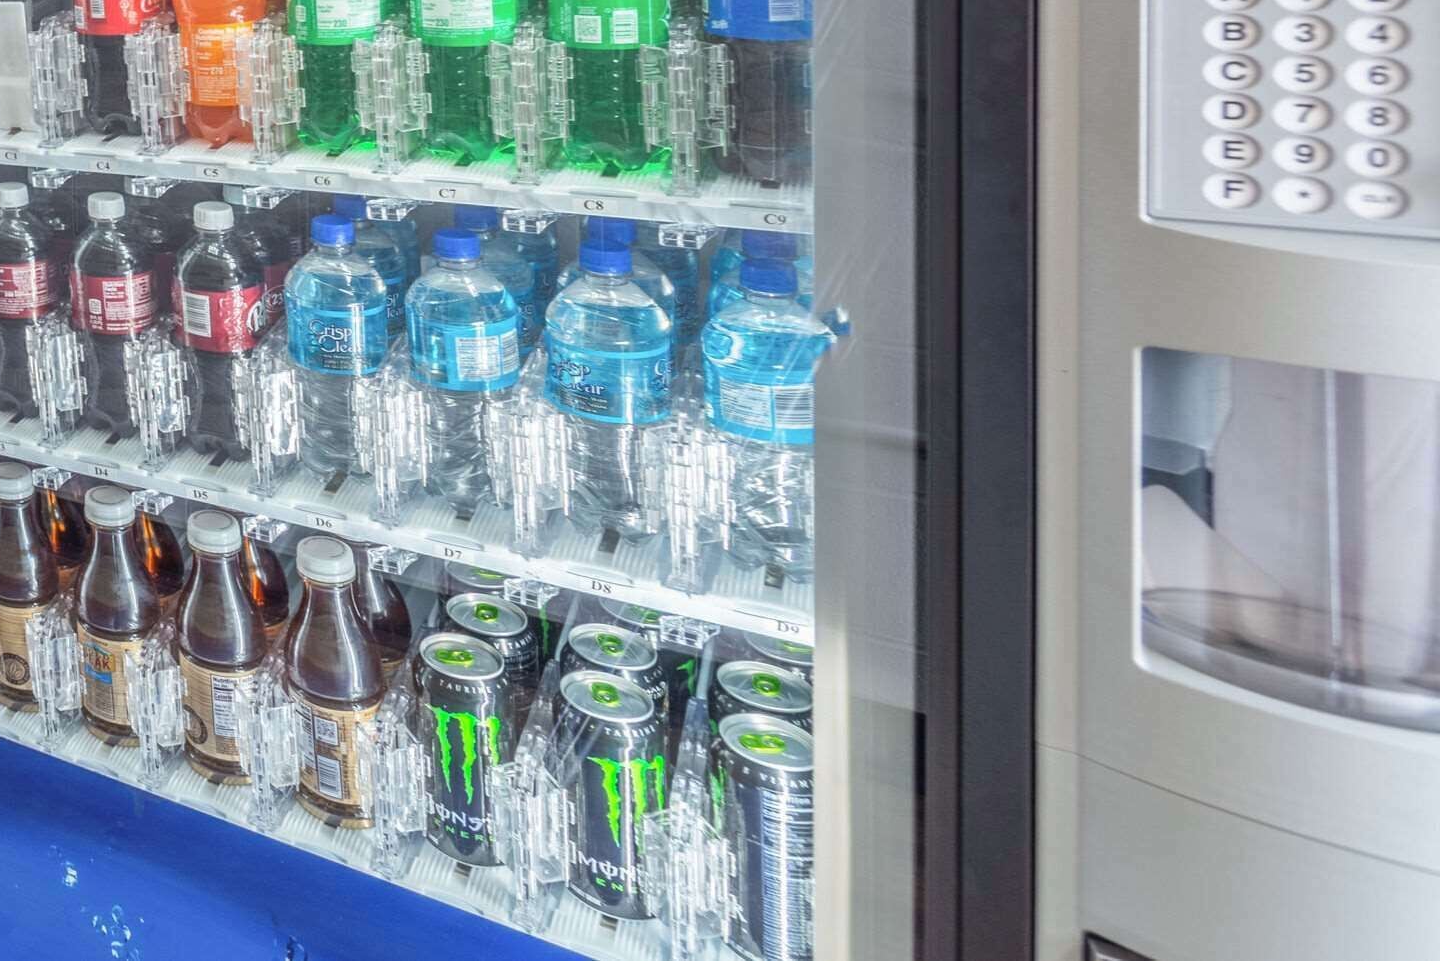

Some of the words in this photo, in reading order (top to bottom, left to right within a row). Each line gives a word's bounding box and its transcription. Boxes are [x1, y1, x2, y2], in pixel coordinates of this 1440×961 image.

[1221, 22, 1246, 41] B
[1294, 23, 1315, 42] 3
[1368, 24, 1389, 43] 4
[1221, 61, 1246, 81] C
[1294, 63, 1315, 83] 5
[1368, 65, 1389, 85] 6
[1221, 101, 1246, 120] D
[1293, 103, 1315, 123] 7
[1367, 107, 1389, 126] 8
[4, 151, 17, 160] C3
[1222, 140, 1245, 160] E
[1294, 144, 1315, 163] 9
[1367, 148, 1389, 168] 0
[96, 161, 110, 170] C4
[203, 167, 219, 177] C5
[314, 176, 331, 186] C6
[438, 187, 456, 198] C7
[1222, 180, 1245, 199] F
[583, 199, 604, 211] C8
[763, 213, 787, 226] C9
[309, 319, 353, 343] Crisp
[94, 467, 109, 477] D4
[193, 490, 208, 500] D5
[315, 517, 332, 528] D6
[443, 546, 462, 560] D7
[590, 579, 612, 595] D8
[776, 620, 800, 634] D9
